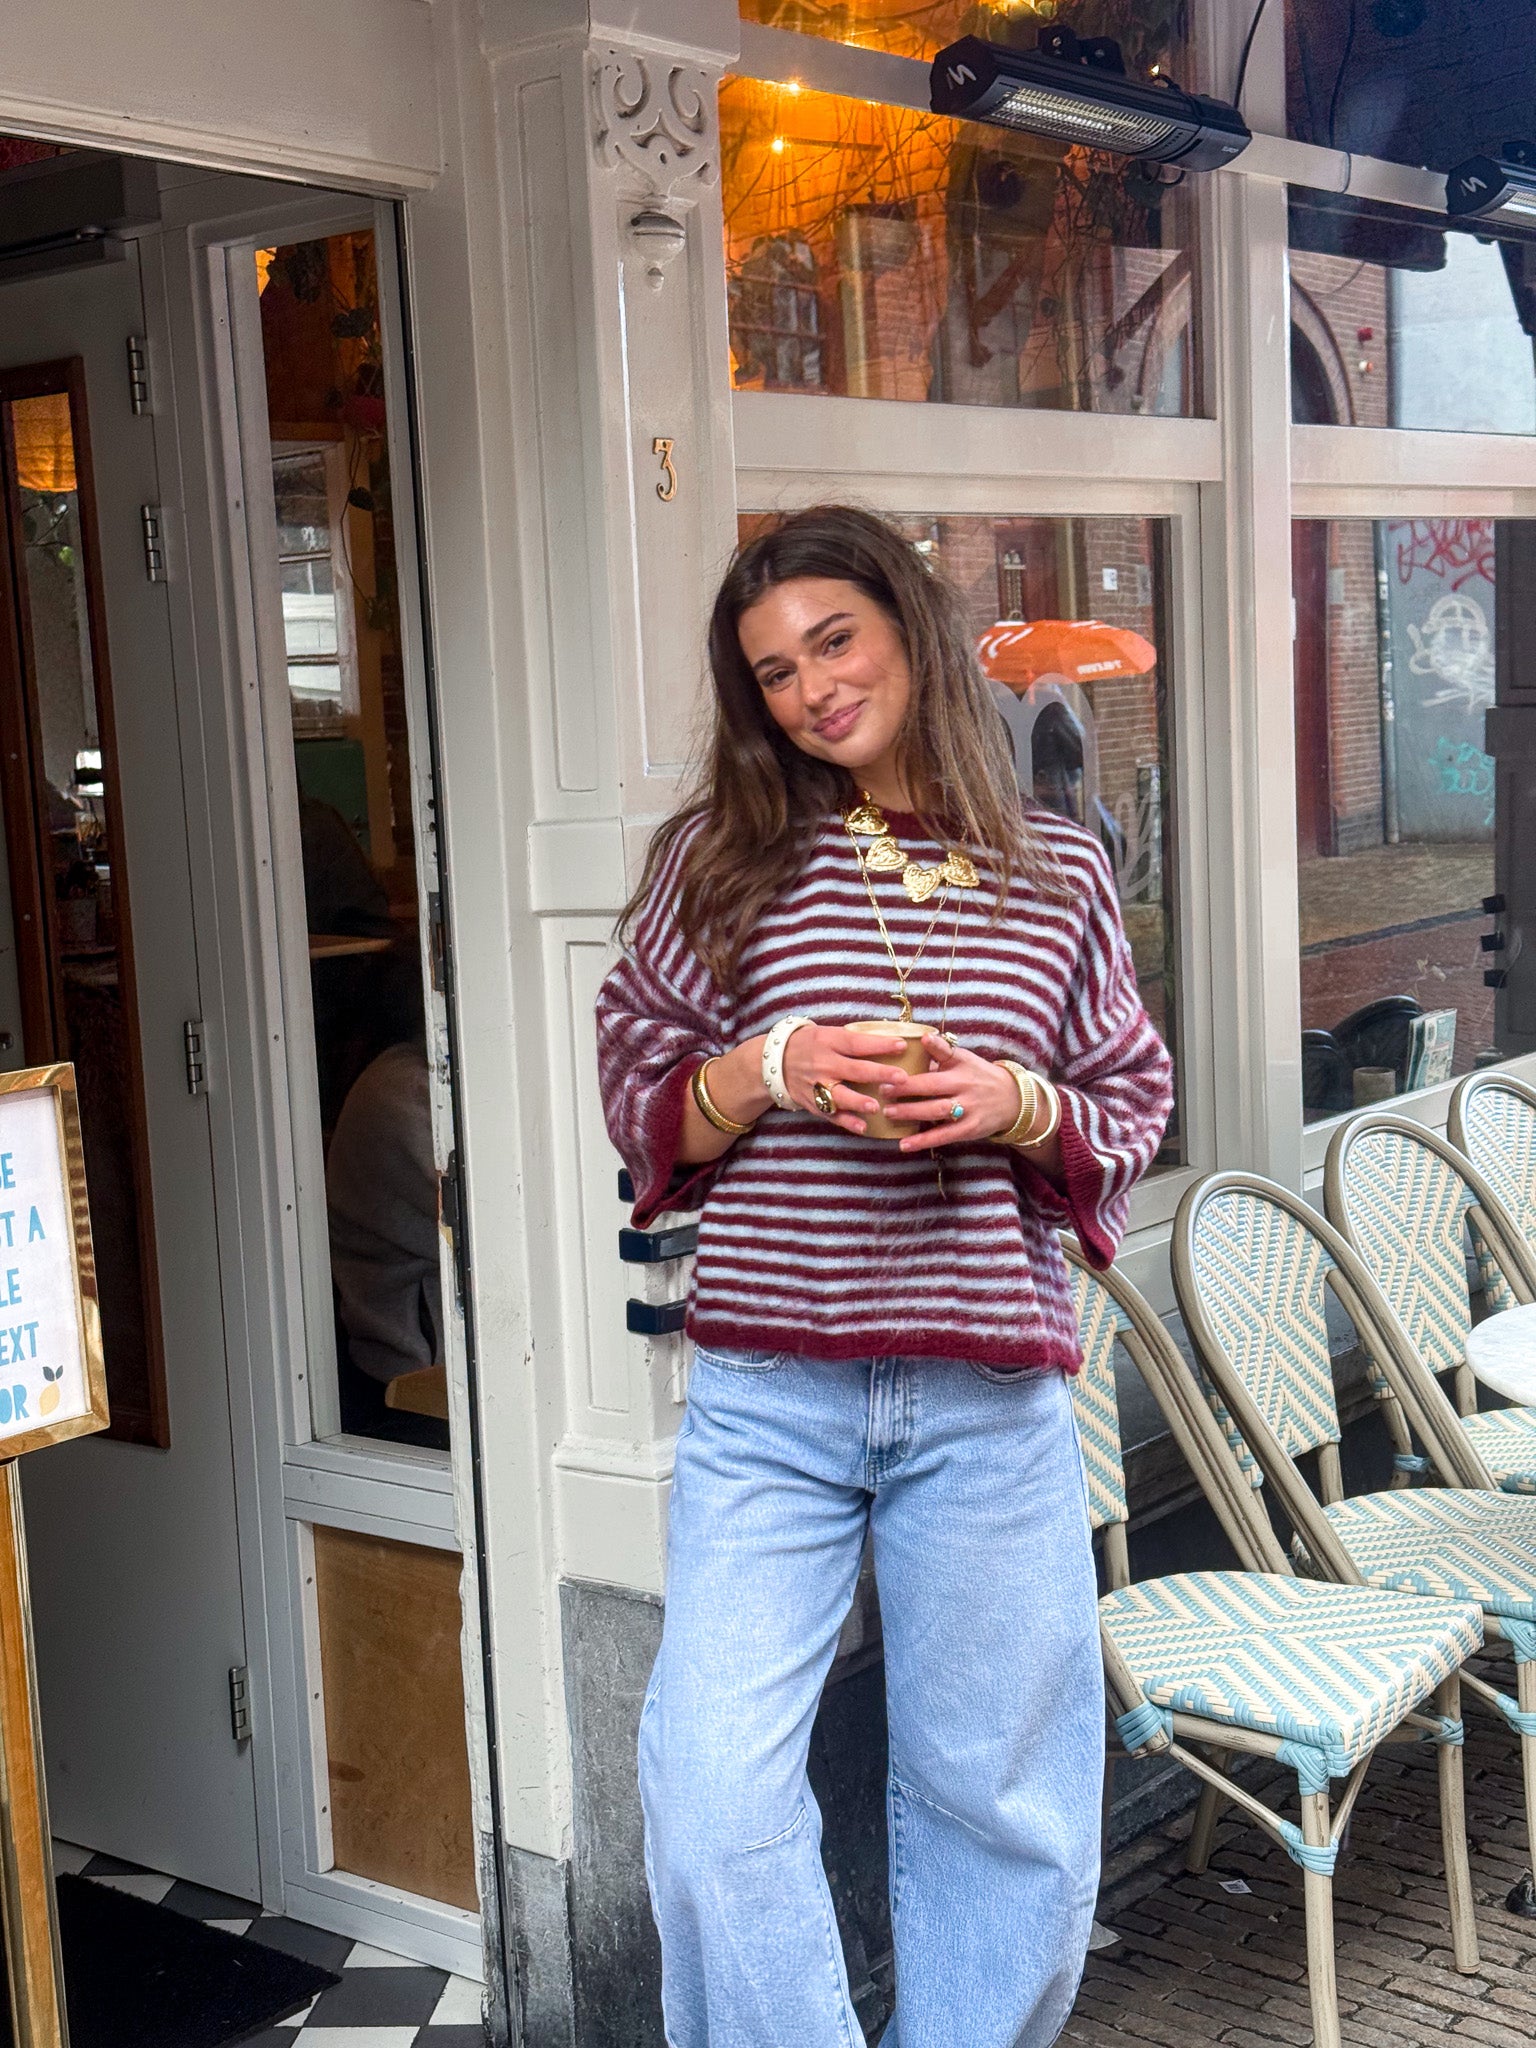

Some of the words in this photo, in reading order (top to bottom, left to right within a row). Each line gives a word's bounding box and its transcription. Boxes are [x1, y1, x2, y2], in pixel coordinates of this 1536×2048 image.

[652, 437, 678, 502] 3
[0, 1152, 16, 1189] E
[0, 1210, 15, 1247] T
[29, 1205, 46, 1243] A
[0, 1321, 39, 1366] EXT
